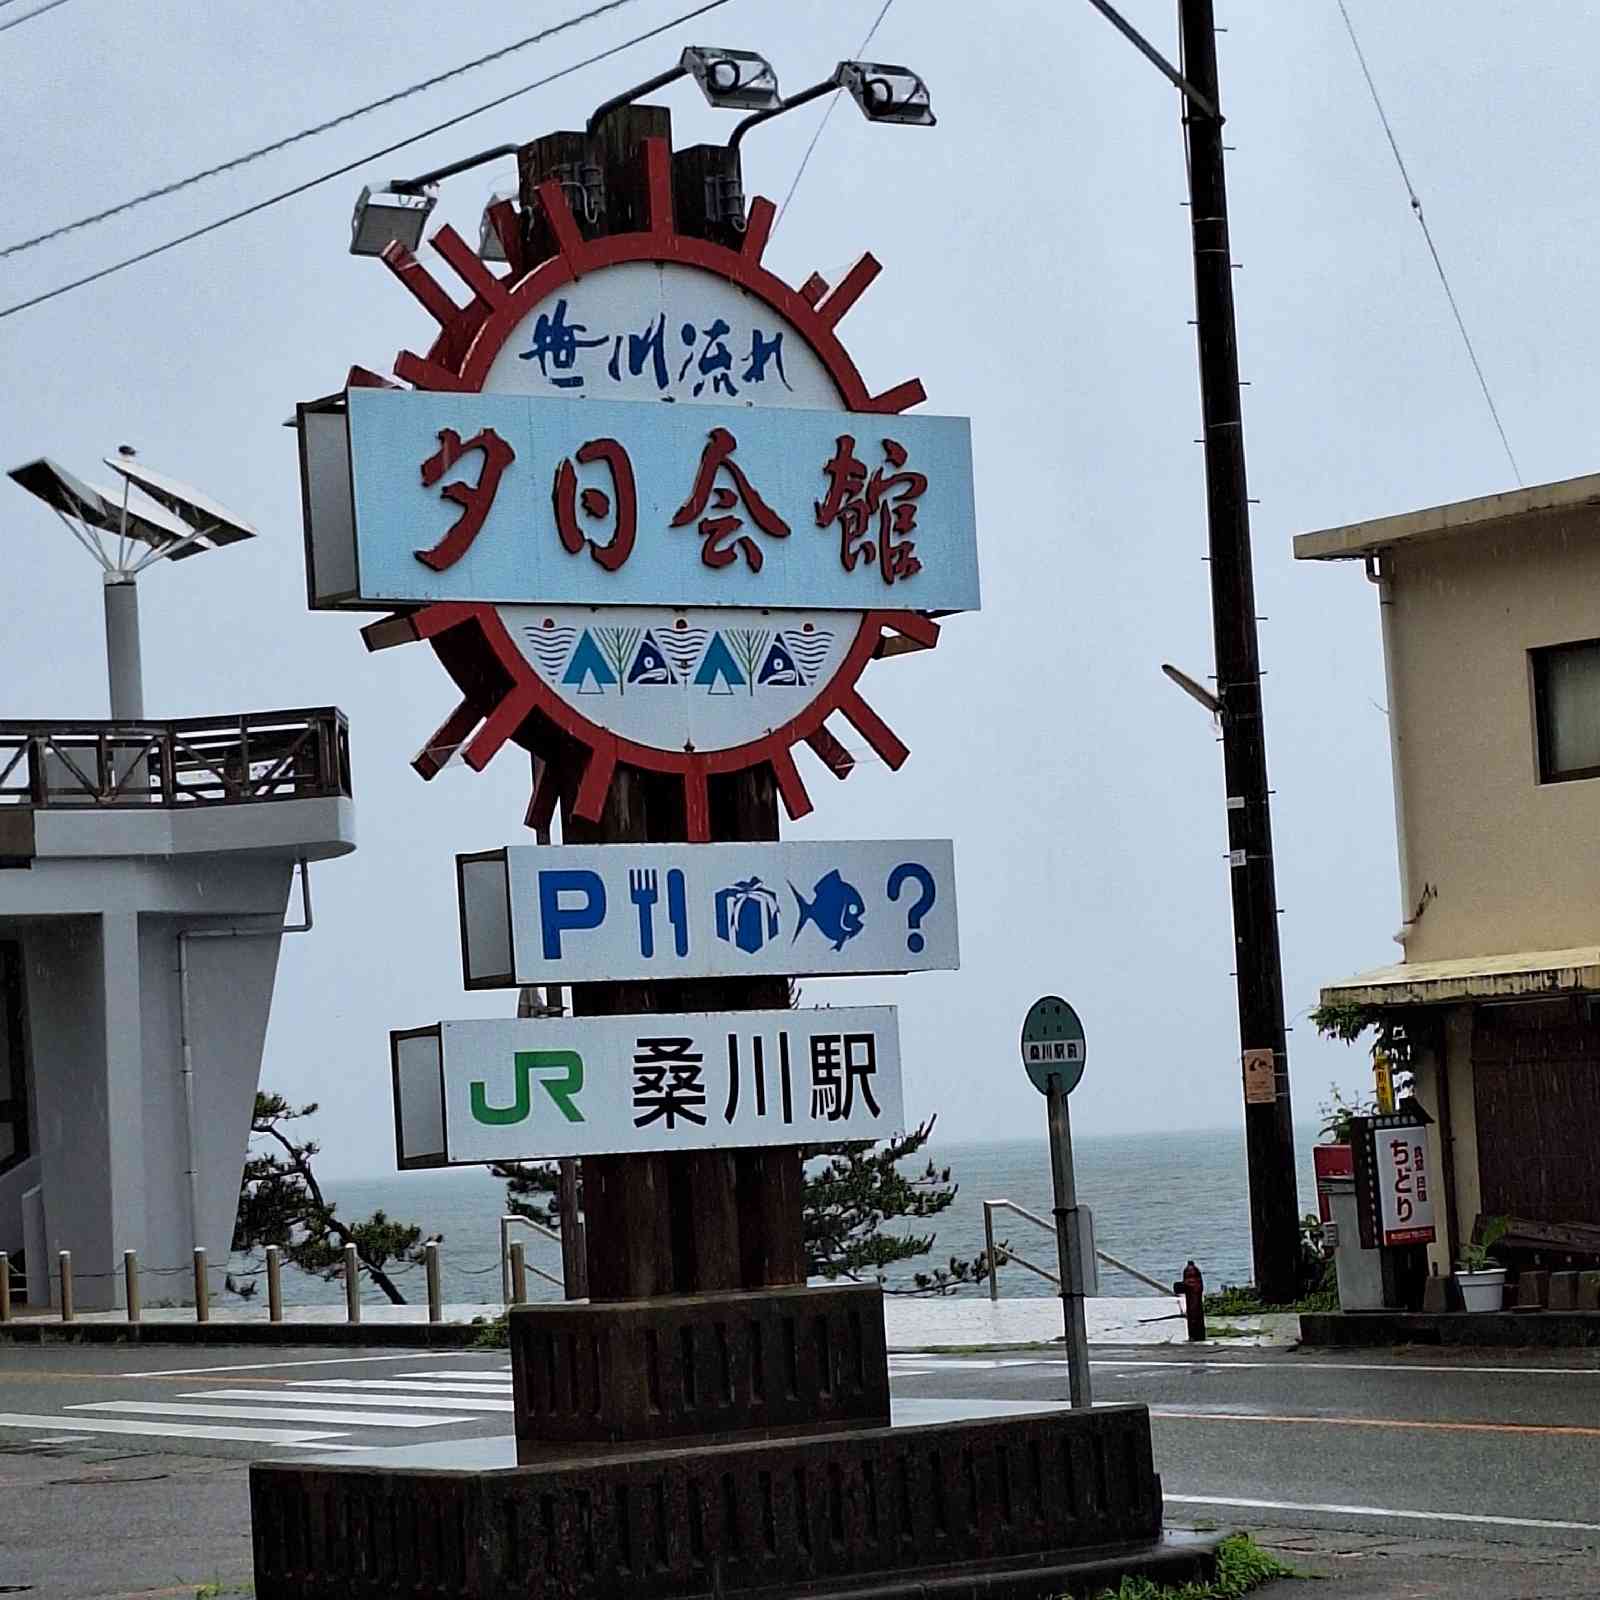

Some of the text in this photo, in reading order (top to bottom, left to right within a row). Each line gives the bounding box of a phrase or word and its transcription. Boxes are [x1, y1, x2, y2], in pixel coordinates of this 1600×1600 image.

[519, 299, 794, 396] 笹川流れ
[412, 427, 929, 586] 夕日会館
[538, 862, 936, 960] P ?
[470, 1031, 881, 1130] JR 桑川駅
[1389, 1138, 1413, 1223] ちどり
